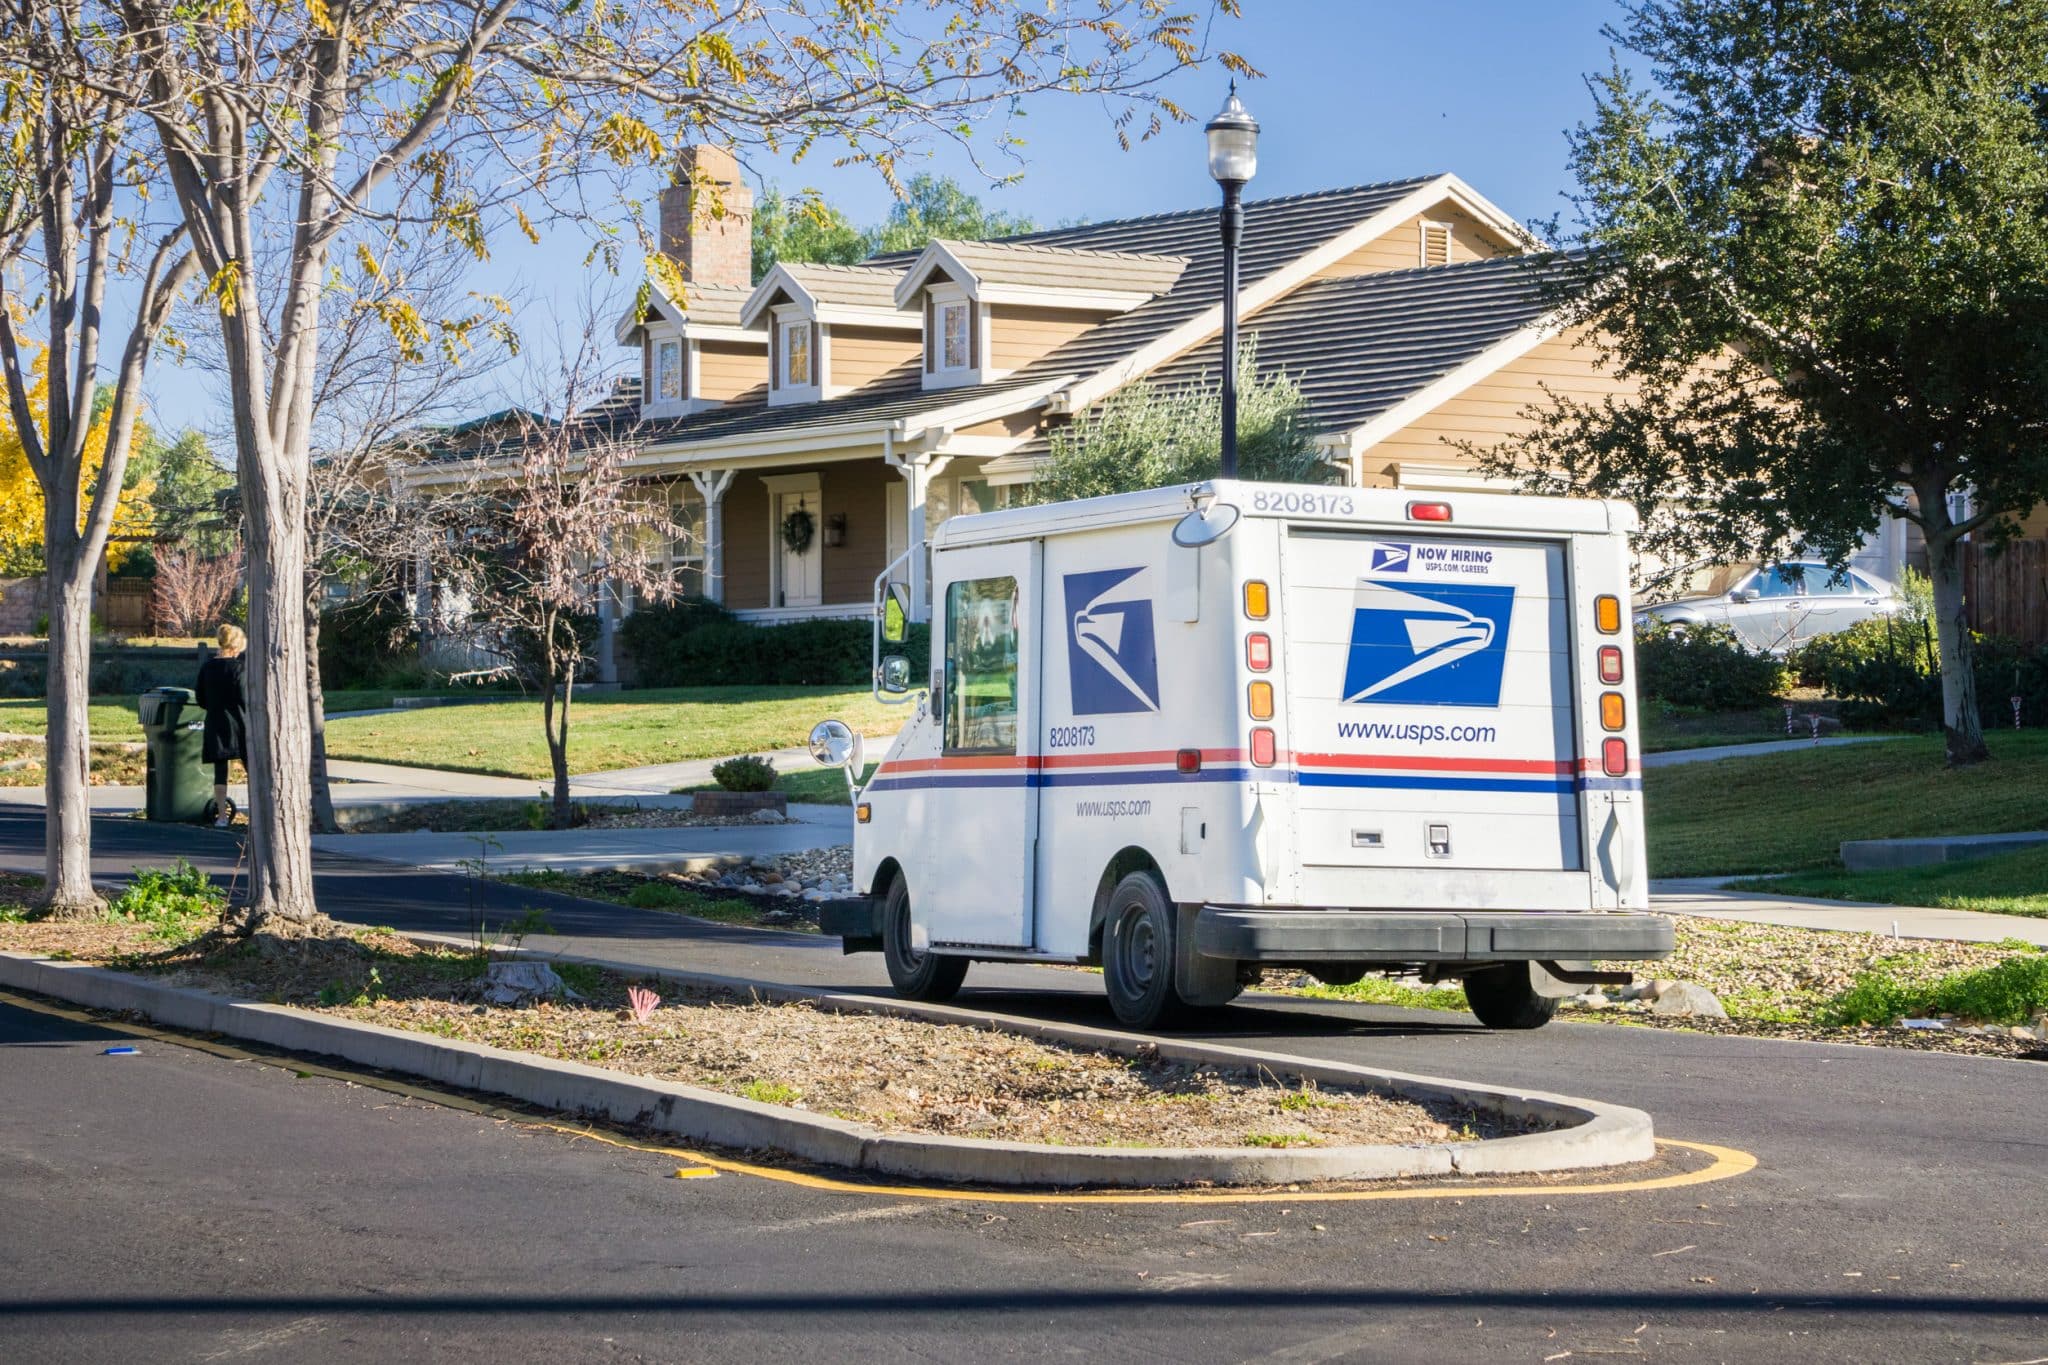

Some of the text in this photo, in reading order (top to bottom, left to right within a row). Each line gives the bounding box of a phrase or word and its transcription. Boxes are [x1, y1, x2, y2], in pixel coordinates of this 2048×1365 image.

[1254, 490, 1354, 515] 8208173
[1416, 547, 1493, 563] NOW HIRING
[1050, 725, 1095, 748] 8208173
[1337, 722, 1496, 745] www.usps.com
[1076, 800, 1151, 820] www.usps.com
